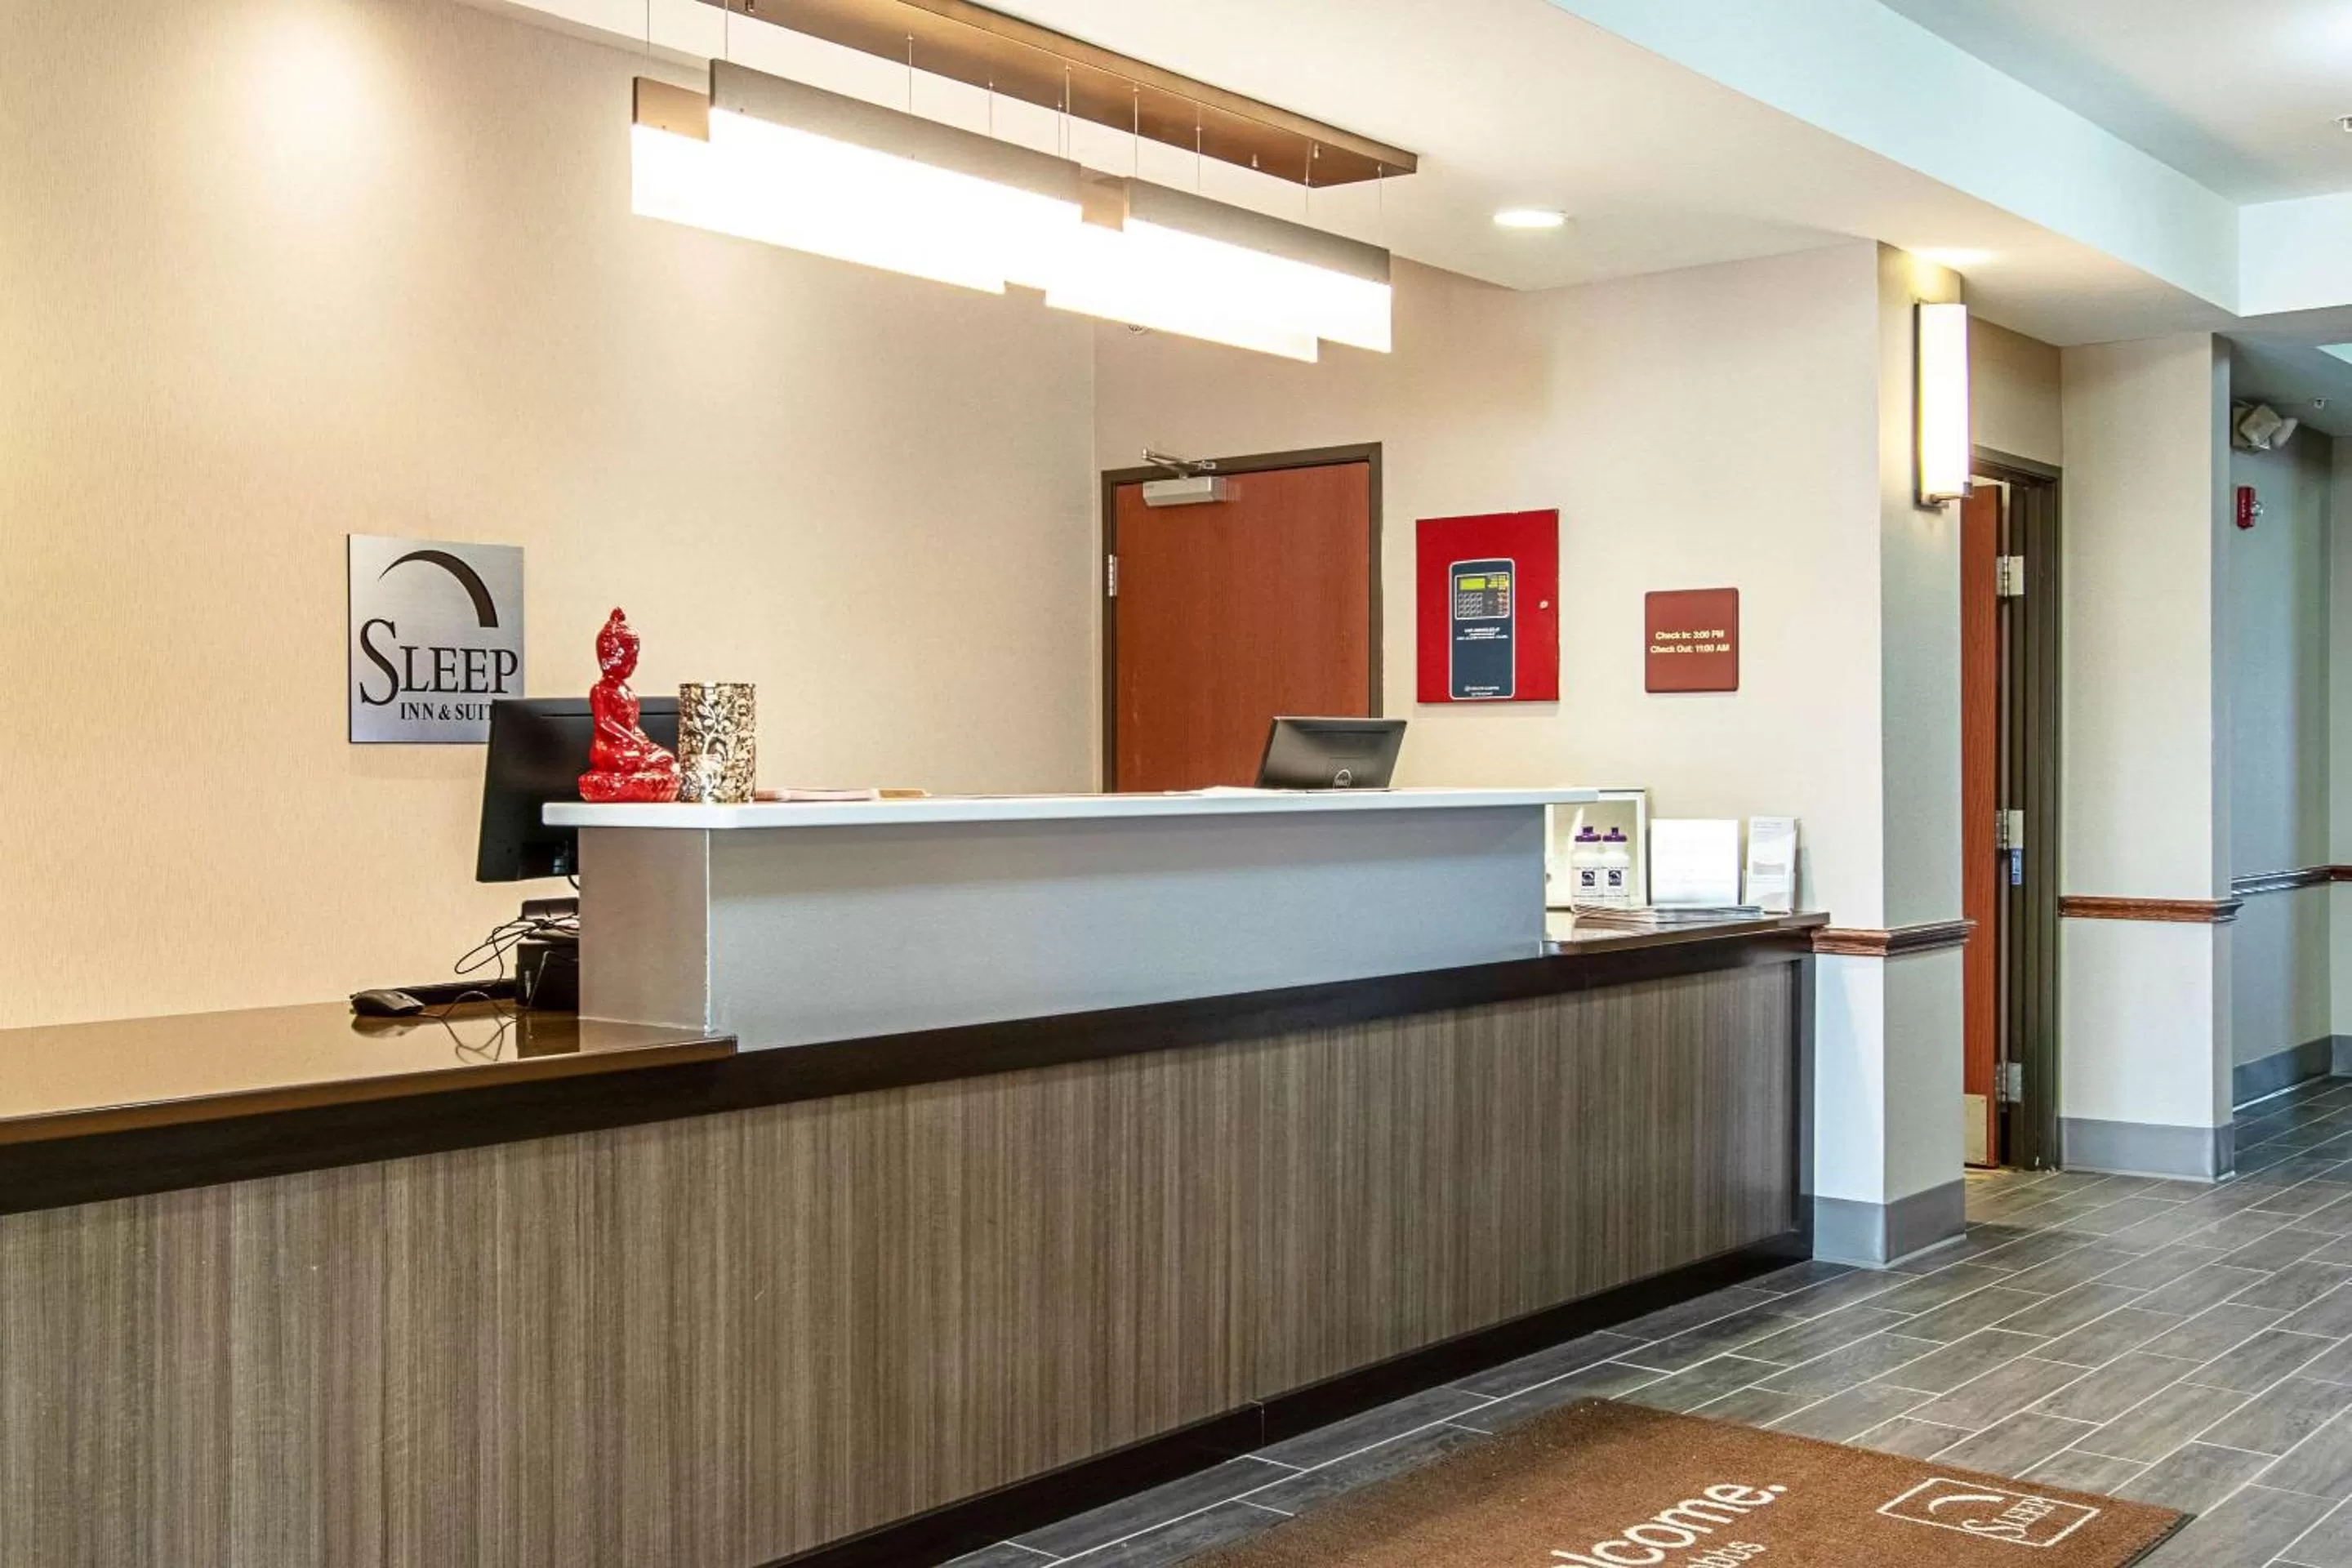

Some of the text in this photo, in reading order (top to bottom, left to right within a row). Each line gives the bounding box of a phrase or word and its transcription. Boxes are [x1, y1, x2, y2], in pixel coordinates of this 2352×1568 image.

[1650, 644, 1675, 653] Check
[1715, 643, 1731, 653] AM
[1655, 630, 1680, 640] Check
[1711, 629, 1725, 639] PM
[359, 618, 518, 706] SLEEP
[399, 702, 434, 720] INN
[439, 704, 451, 720] &
[1549, 1483, 1788, 1568] lcome.
[1961, 1497, 2056, 1540] SLEEP
[1686, 1541, 1766, 1568] bbs
